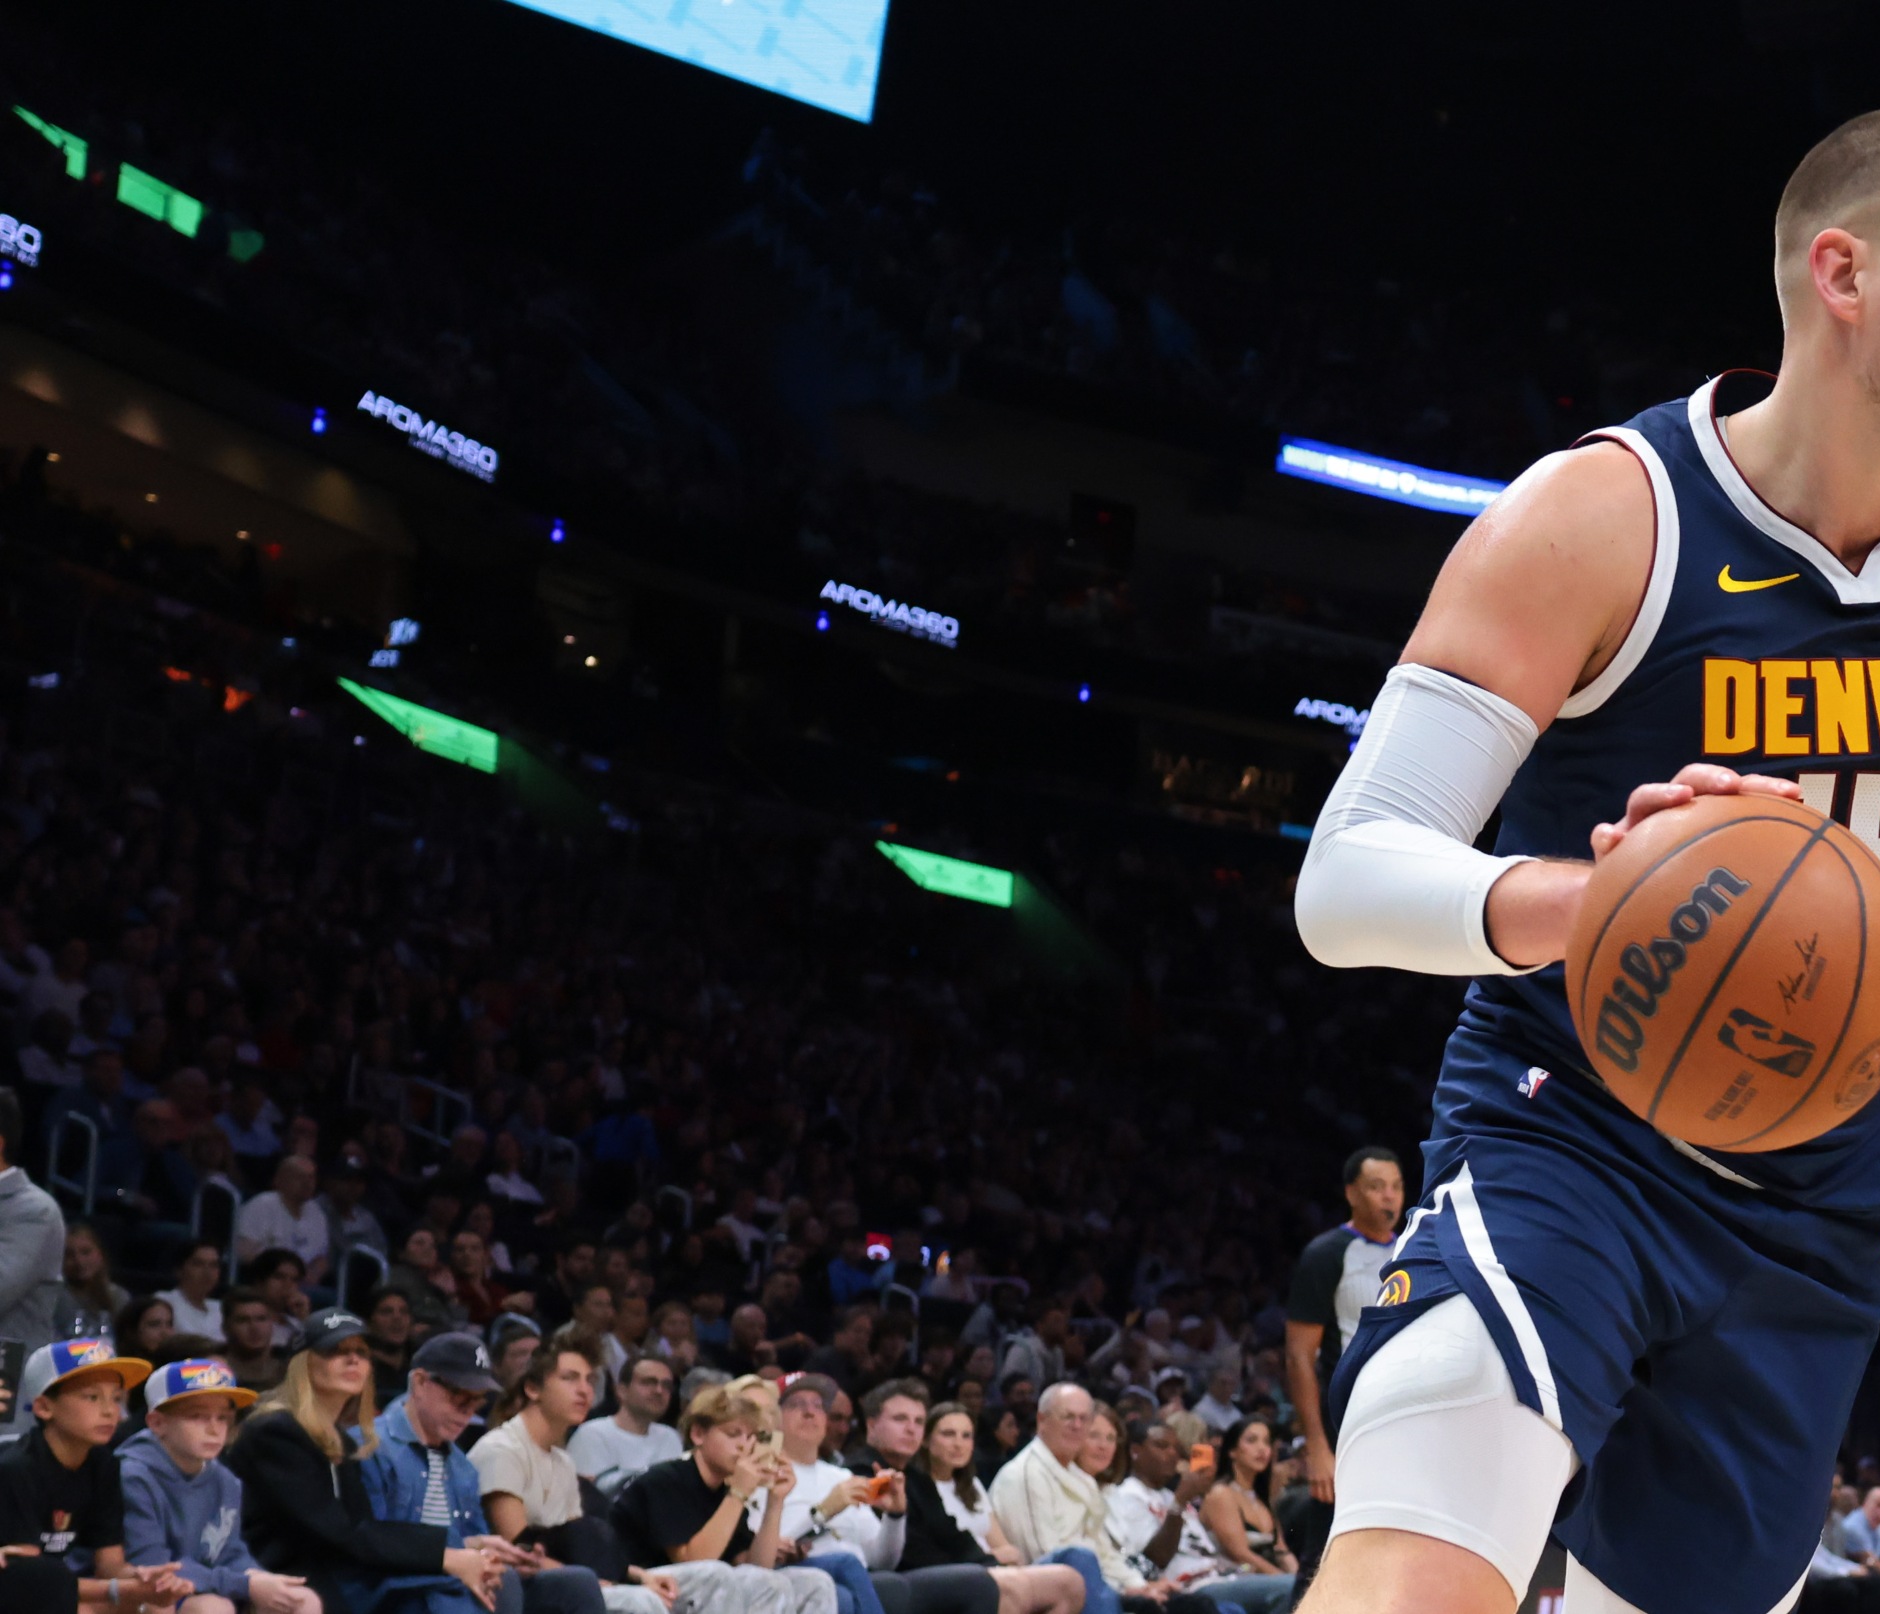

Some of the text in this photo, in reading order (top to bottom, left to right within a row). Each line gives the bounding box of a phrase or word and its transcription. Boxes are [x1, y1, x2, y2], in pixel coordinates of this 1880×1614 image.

[357, 389, 497, 472] AROMA360
[820, 579, 959, 639] AROMA360
[1596, 866, 1752, 1075] Wilson
